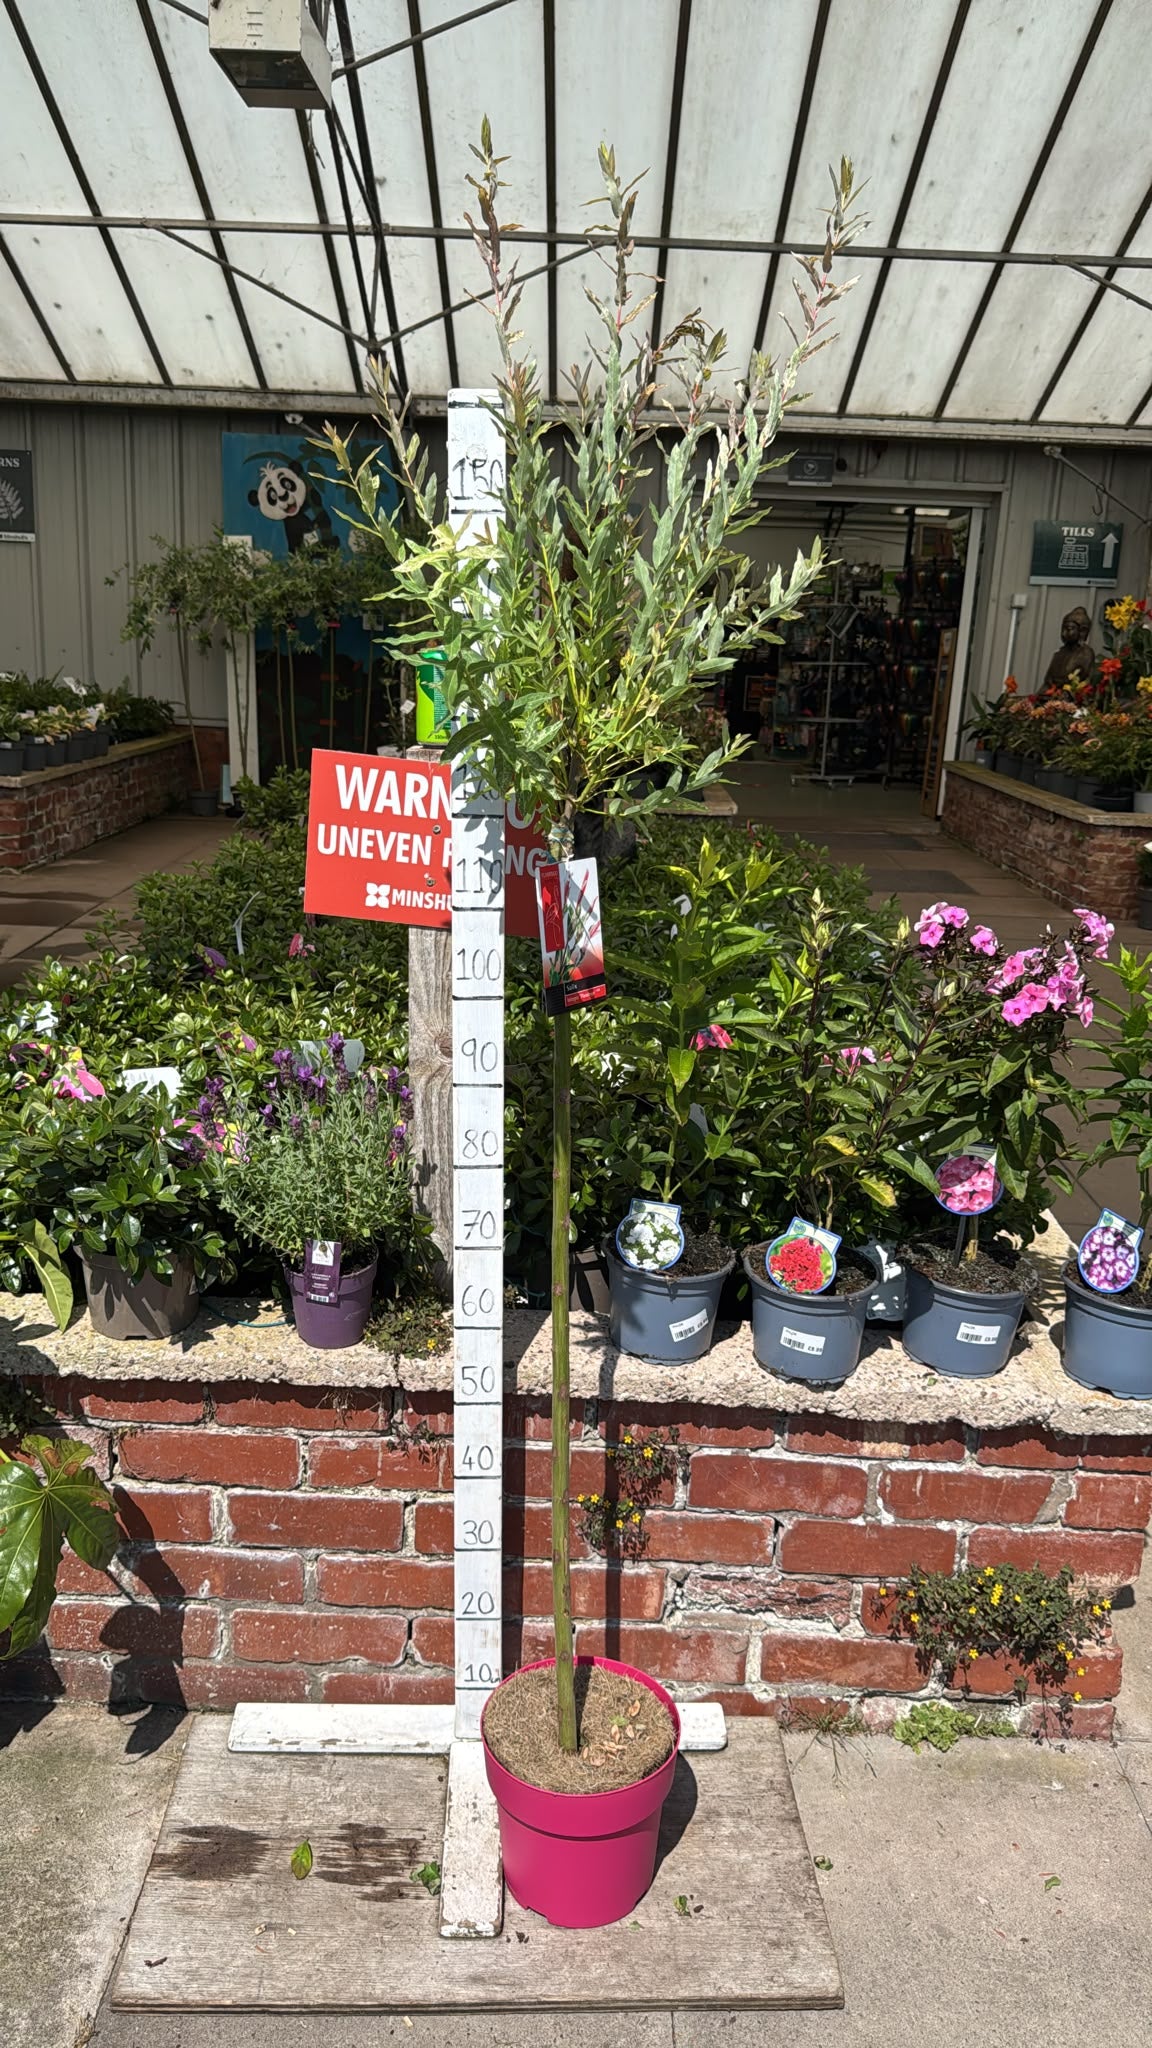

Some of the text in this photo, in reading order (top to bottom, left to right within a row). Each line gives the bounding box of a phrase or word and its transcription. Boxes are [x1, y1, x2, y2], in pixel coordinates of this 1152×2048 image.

[1061, 526, 1095, 537] TILLS
[317, 823, 432, 867] UNEVEN
[455, 857, 502, 894] 110
[456, 948, 501, 980] 100
[461, 1038, 498, 1072] 90
[462, 1129, 498, 1159] 80
[462, 1209, 496, 1240] 70
[462, 1285, 494, 1316] 60
[462, 1365, 495, 1396] 50
[462, 1445, 494, 1471] 40
[463, 1519, 494, 1545] 30
[462, 1591, 495, 1615] 20
